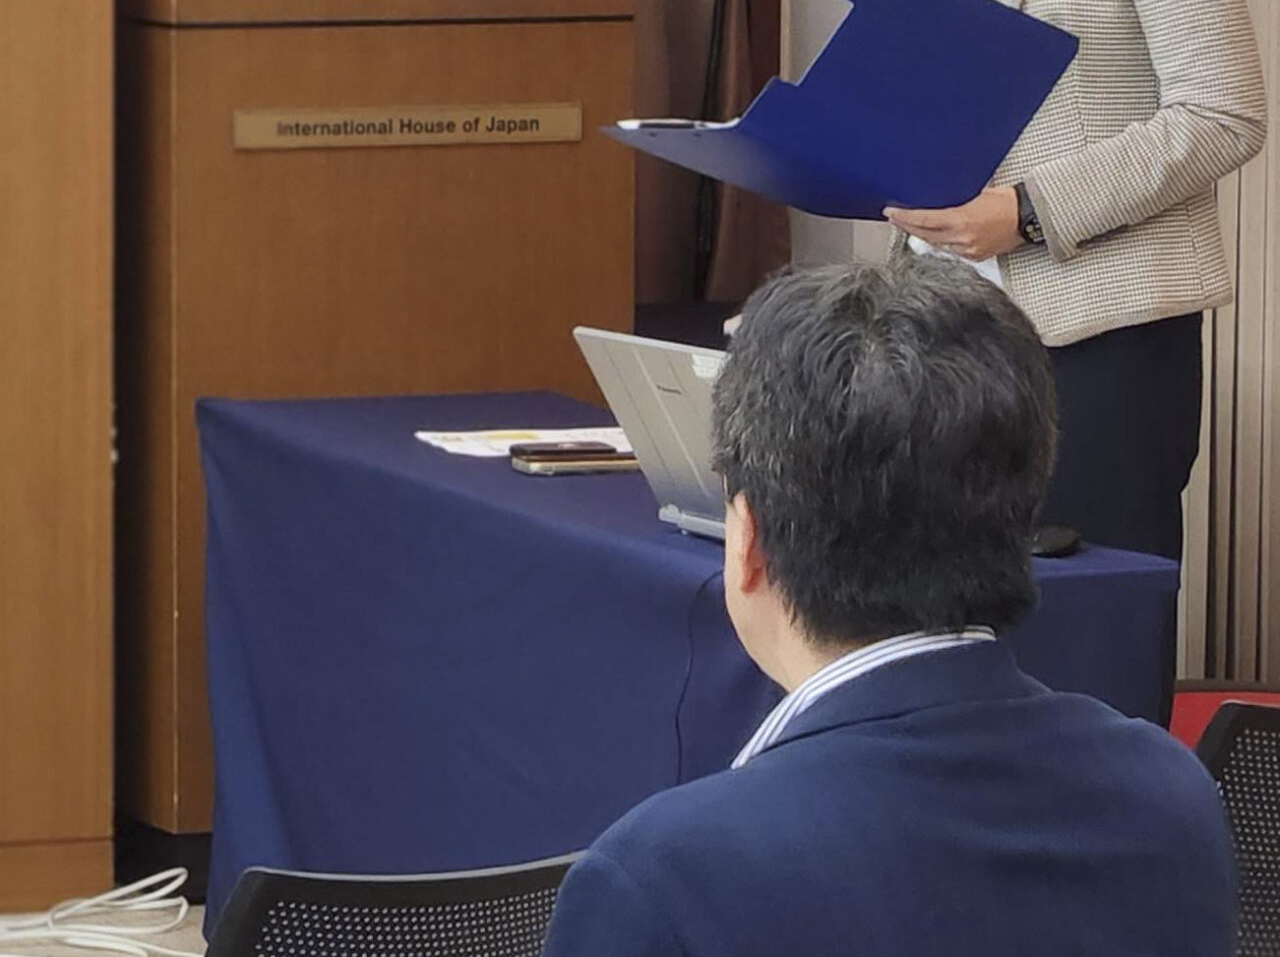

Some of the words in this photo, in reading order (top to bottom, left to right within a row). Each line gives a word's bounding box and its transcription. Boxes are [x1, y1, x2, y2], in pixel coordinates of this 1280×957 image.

[276, 119, 393, 137] International
[400, 118, 456, 134] House
[463, 117, 480, 133] of
[486, 116, 540, 135] Japan
